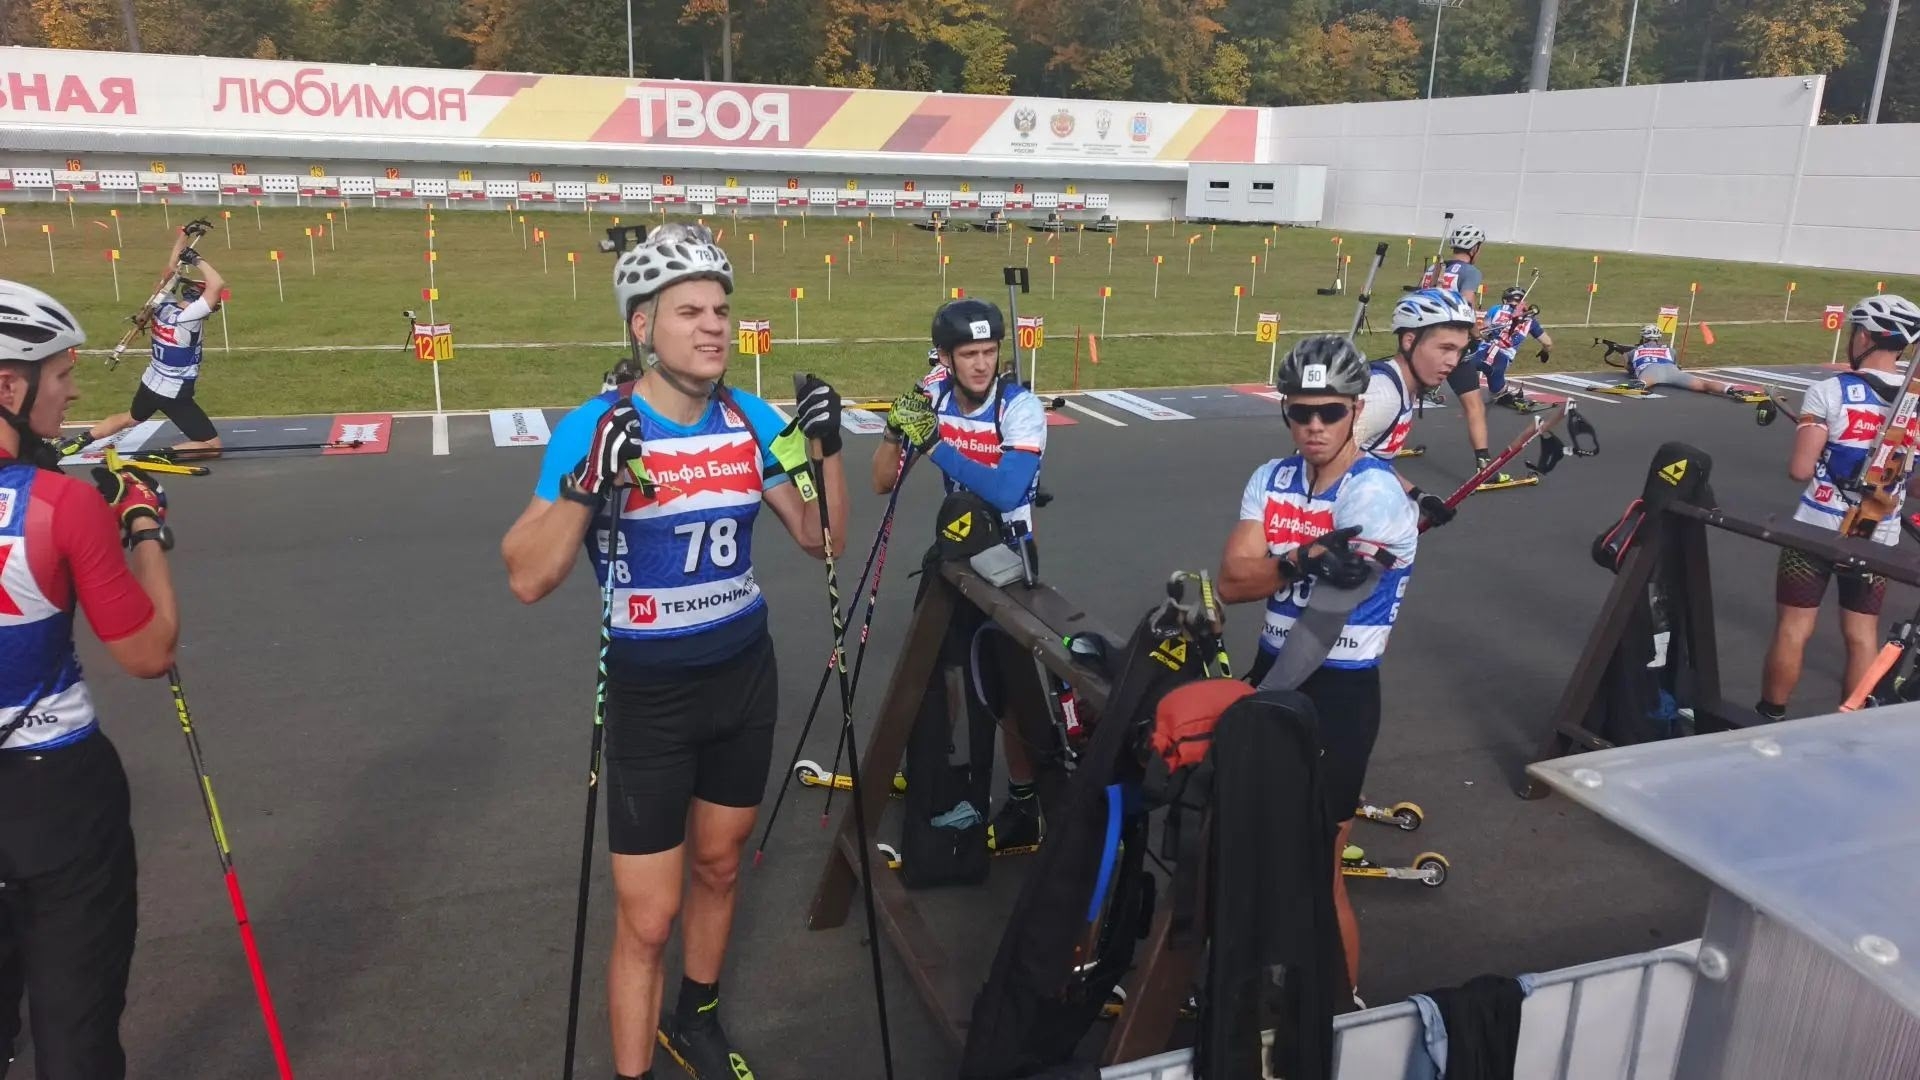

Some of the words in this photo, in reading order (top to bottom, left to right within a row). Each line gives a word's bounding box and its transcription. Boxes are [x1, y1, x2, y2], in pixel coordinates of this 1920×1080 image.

[626, 86, 790, 141] ТВОЯ
[696, 250, 711, 260] 78
[976, 325, 987, 334] 38
[1663, 316, 1673, 331] 7
[1827, 313, 1838, 329] 6
[759, 331, 769, 352] 10
[1018, 328, 1034, 348] 10
[1262, 323, 1271, 340] 9
[416, 335, 434, 359] 12
[436, 336, 450, 358] 11
[742, 332, 754, 353] 11
[1308, 370, 1321, 382] 50
[970, 438, 1004, 453] Банк
[645, 463, 707, 485] Альфа
[707, 460, 753, 477] Банк
[675, 518, 738, 573] 78
